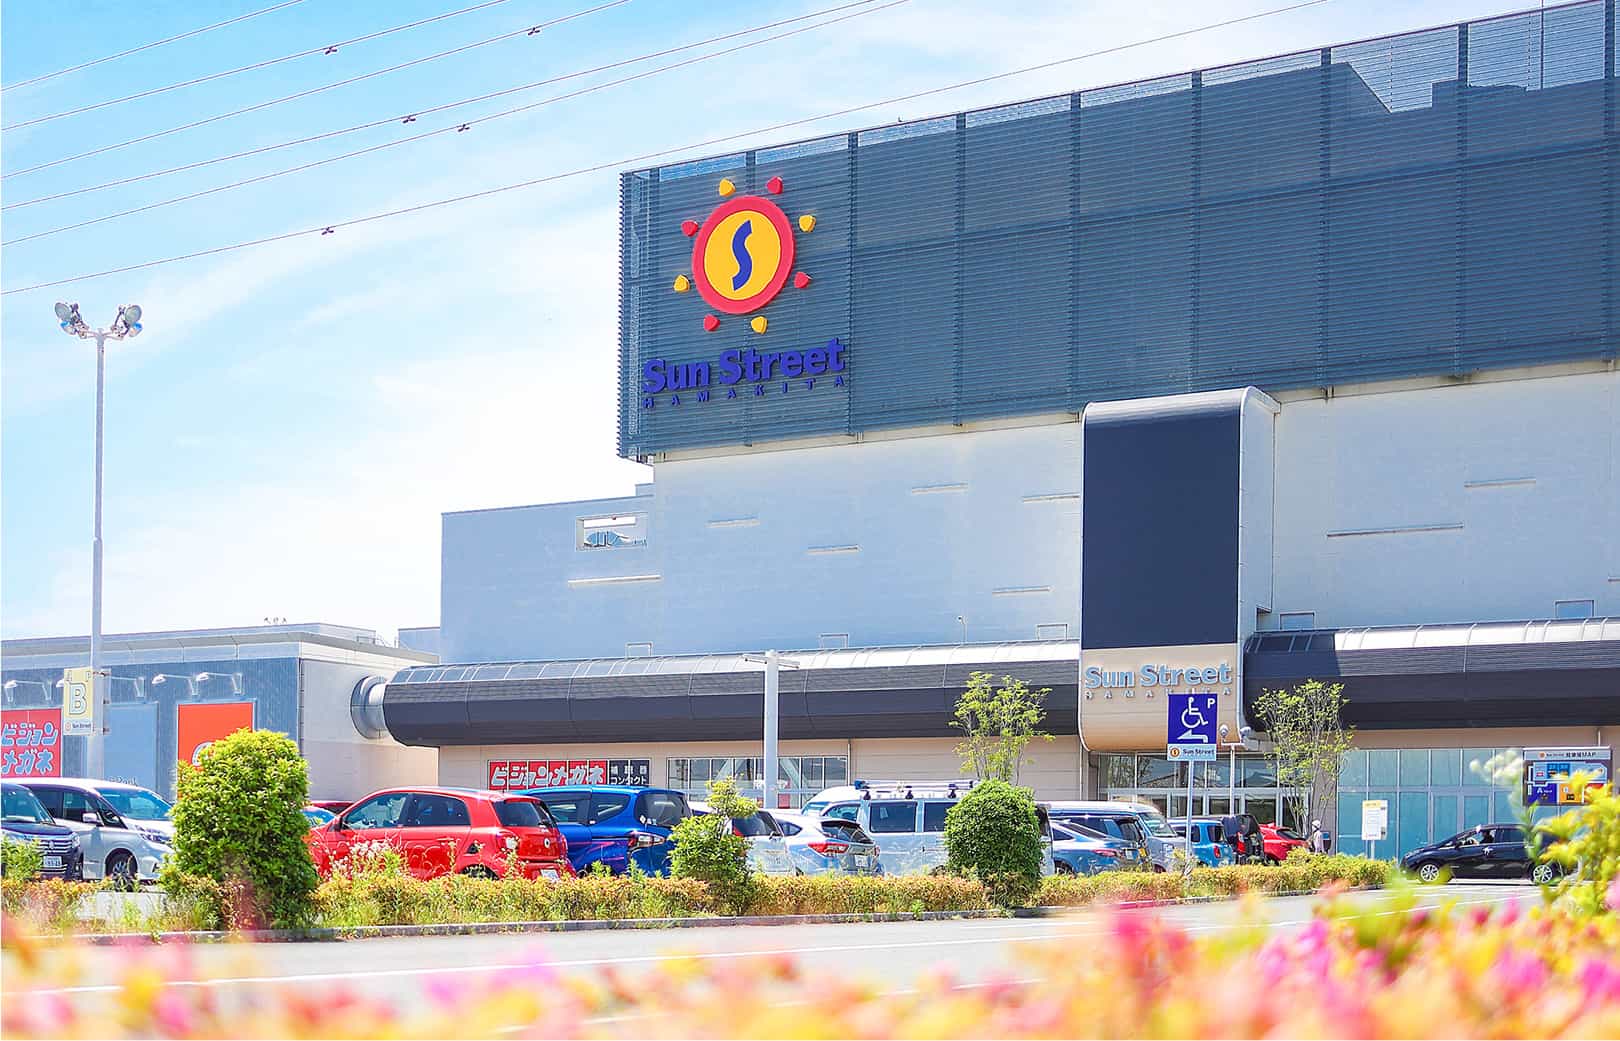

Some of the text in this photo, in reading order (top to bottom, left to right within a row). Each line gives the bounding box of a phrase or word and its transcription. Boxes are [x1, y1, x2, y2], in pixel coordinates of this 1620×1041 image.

[731, 218, 753, 292] S
[642, 337, 846, 394] Sun Street
[643, 375, 845, 409] HAMAKITA
[1085, 662, 1233, 689] Sun Street
[69, 682, 87, 715] B
[1207, 697, 1216, 709] P
[1, 722, 59, 747] ビジョン
[1, 748, 53, 775] メガネ
[491, 765, 604, 787] ビジョンメガネ
